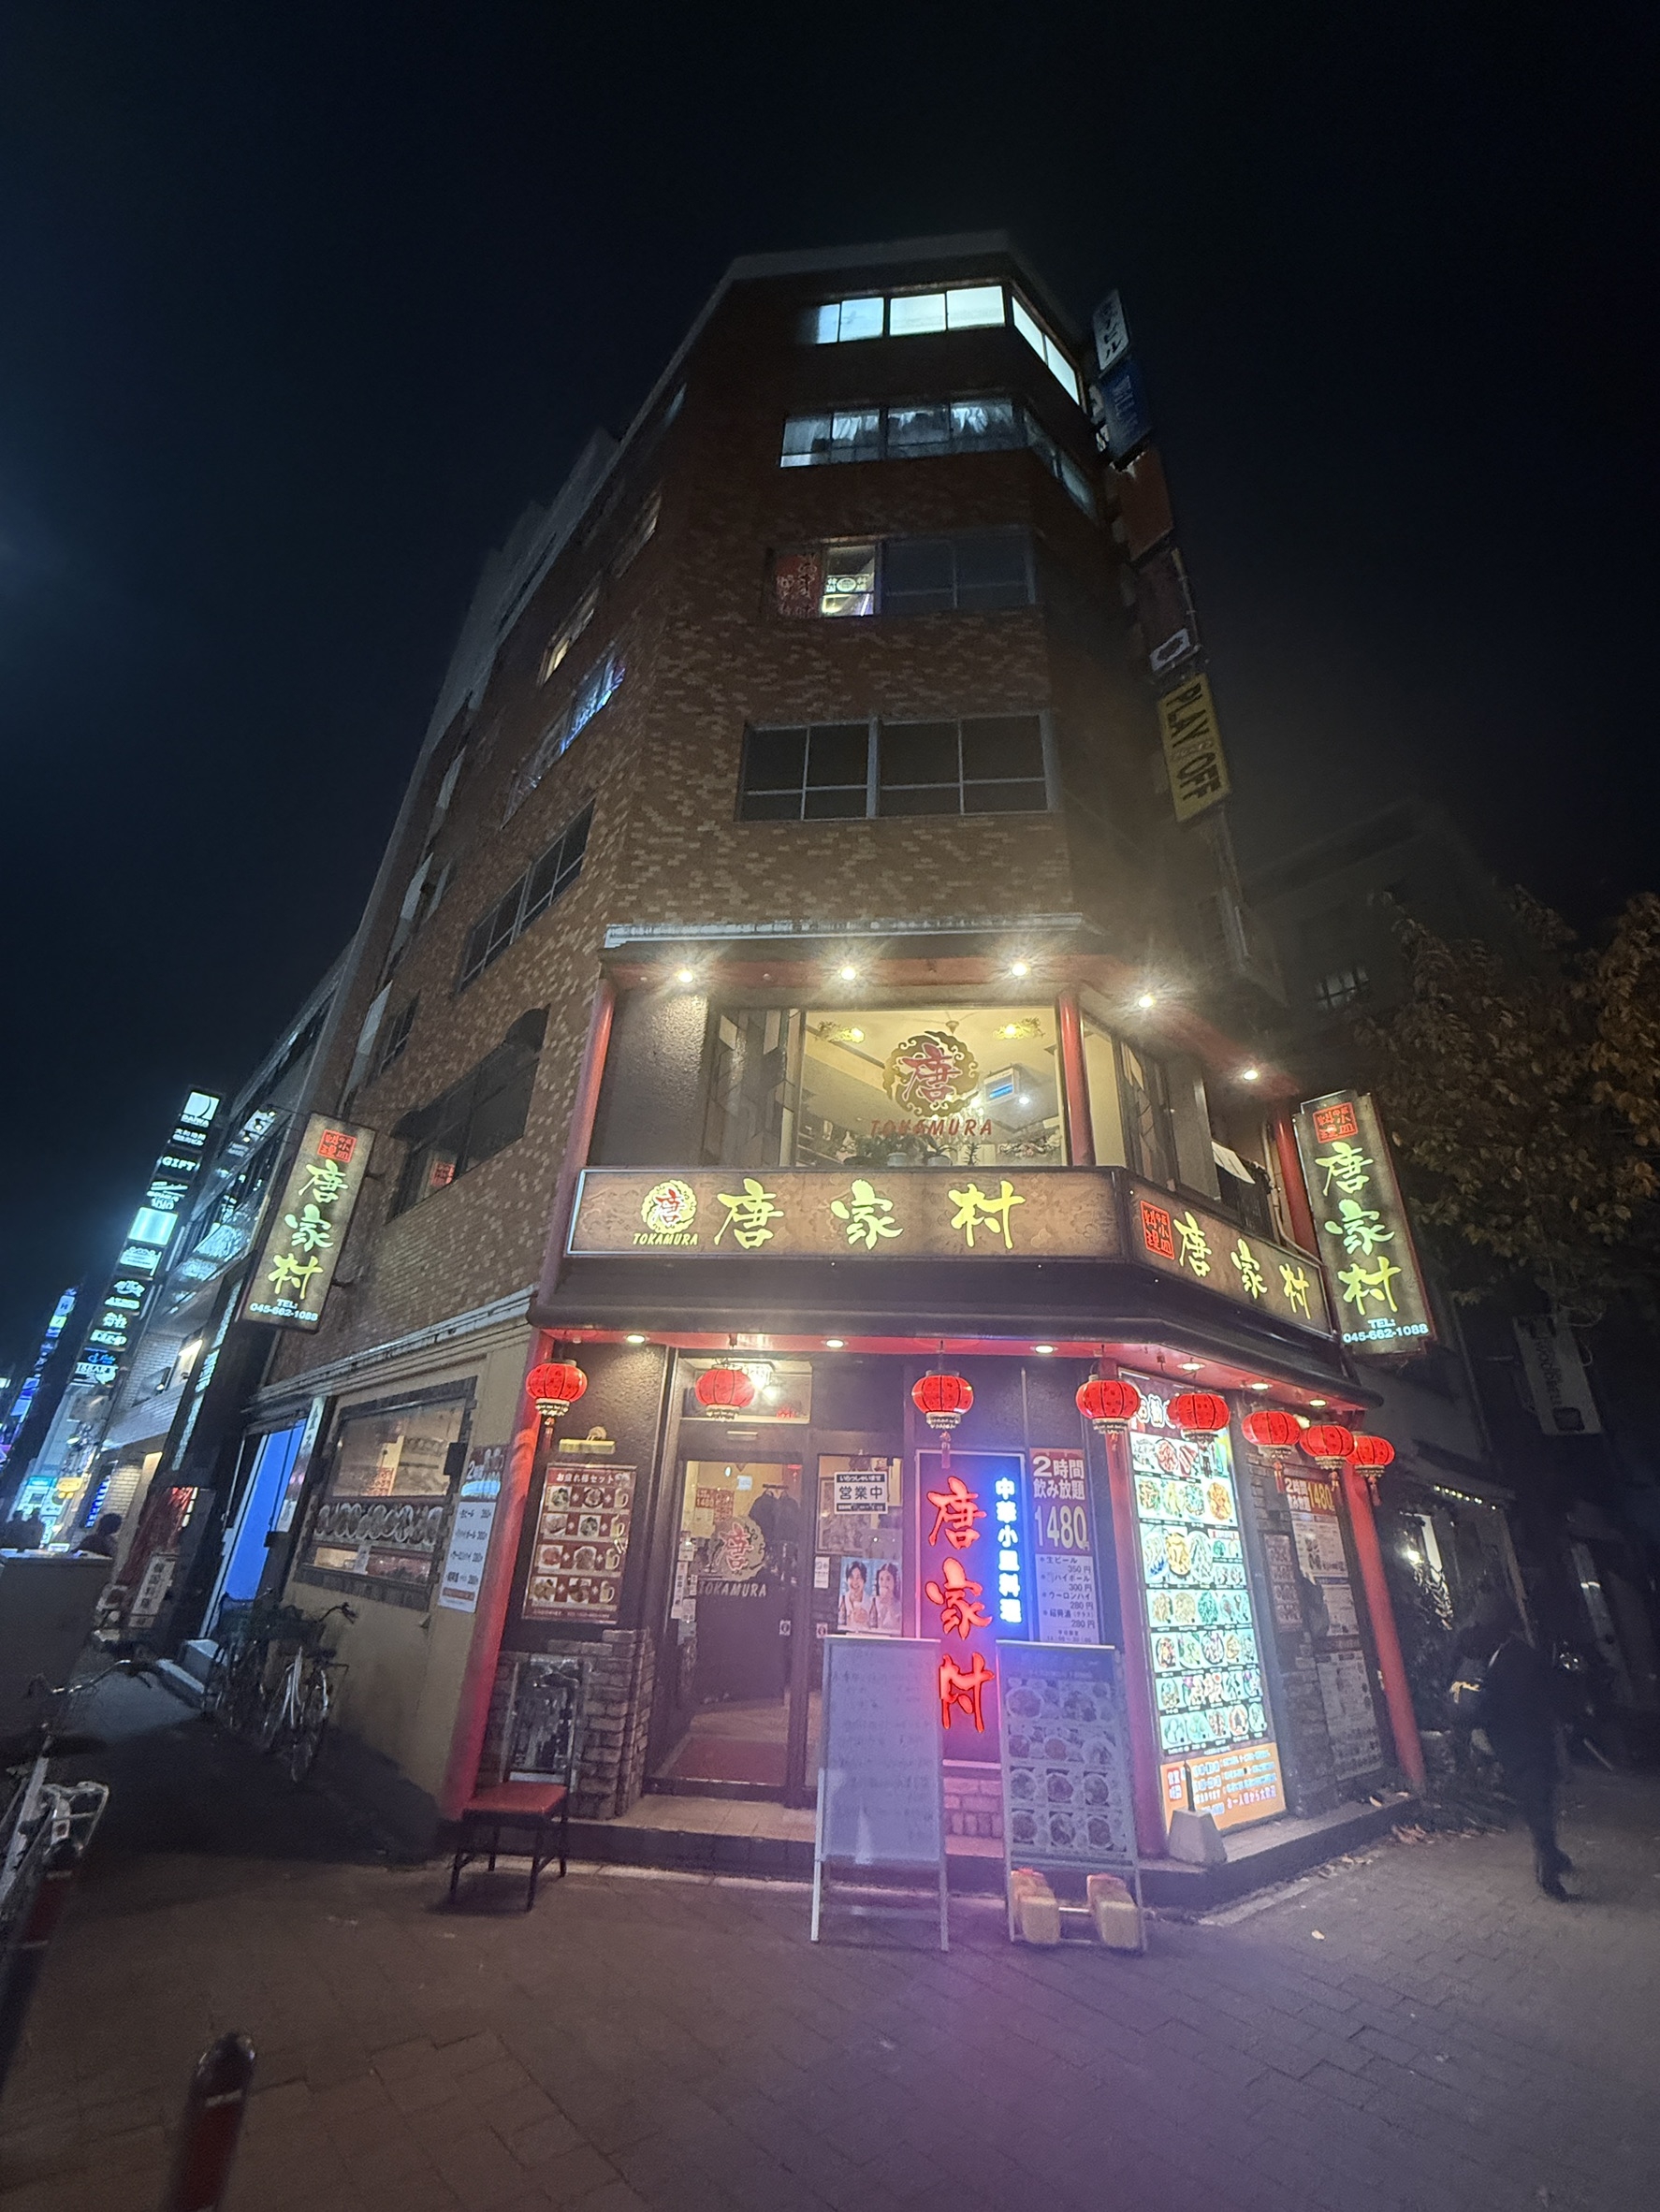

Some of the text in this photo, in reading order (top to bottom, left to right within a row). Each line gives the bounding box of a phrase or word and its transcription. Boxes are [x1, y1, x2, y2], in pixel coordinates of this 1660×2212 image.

[1167, 683, 1221, 800] PLAY OFF
[896, 1042, 963, 1102] 唐
[181, 1113, 209, 1128] DAIWA
[162, 1157, 197, 1171] GIFT
[714, 1179, 1027, 1250] 唐家村
[268, 1158, 349, 1300] 唐家村
[633, 1232, 699, 1245] TOKAMURA
[1315, 1141, 1402, 1316] 唐家村
[1173, 1211, 1310, 1320] 唐家村
[276, 1298, 299, 1309] TEL:
[1343, 1323, 1429, 1345] 045-662-1088
[1368, 1317, 1396, 1330] TEL:
[1033, 1456, 1085, 1479] 2時間
[839, 1486, 882, 1500] 営業中
[1033, 1479, 1085, 1500] 飲み放題
[1308, 1482, 1333, 1510] 1480
[1035, 1505, 1087, 1550] 1480
[698, 1582, 766, 1596] TOKAMURA
[1049, 1591, 1090, 1600] ウーロンハイ
